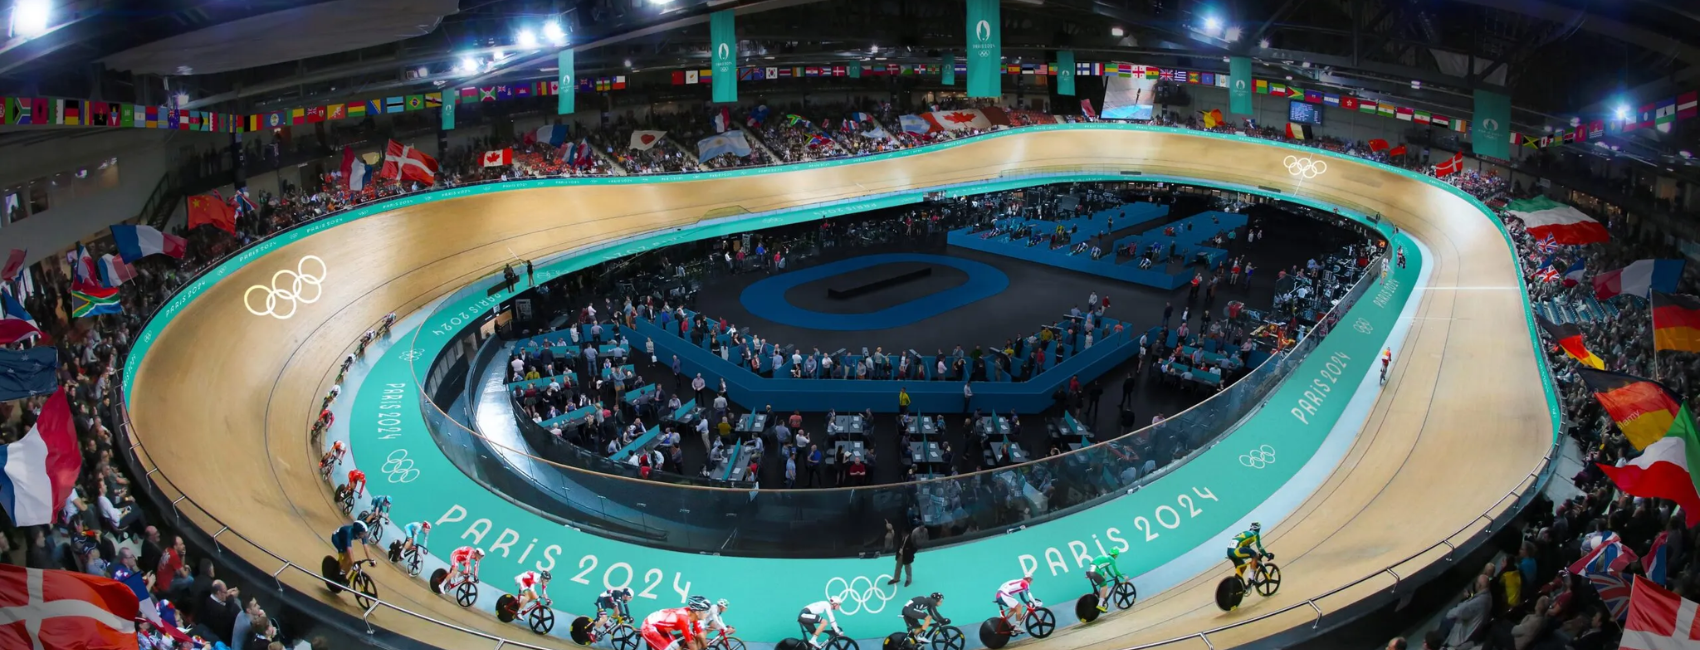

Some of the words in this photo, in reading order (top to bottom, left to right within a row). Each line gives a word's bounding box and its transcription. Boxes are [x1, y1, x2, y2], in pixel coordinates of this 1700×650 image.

[432, 311, 470, 336] 2024
[1320, 351, 1351, 384] 2024
[377, 412, 402, 440] 2024
[1133, 486, 1219, 543] 2024
[570, 554, 692, 604] 2024
